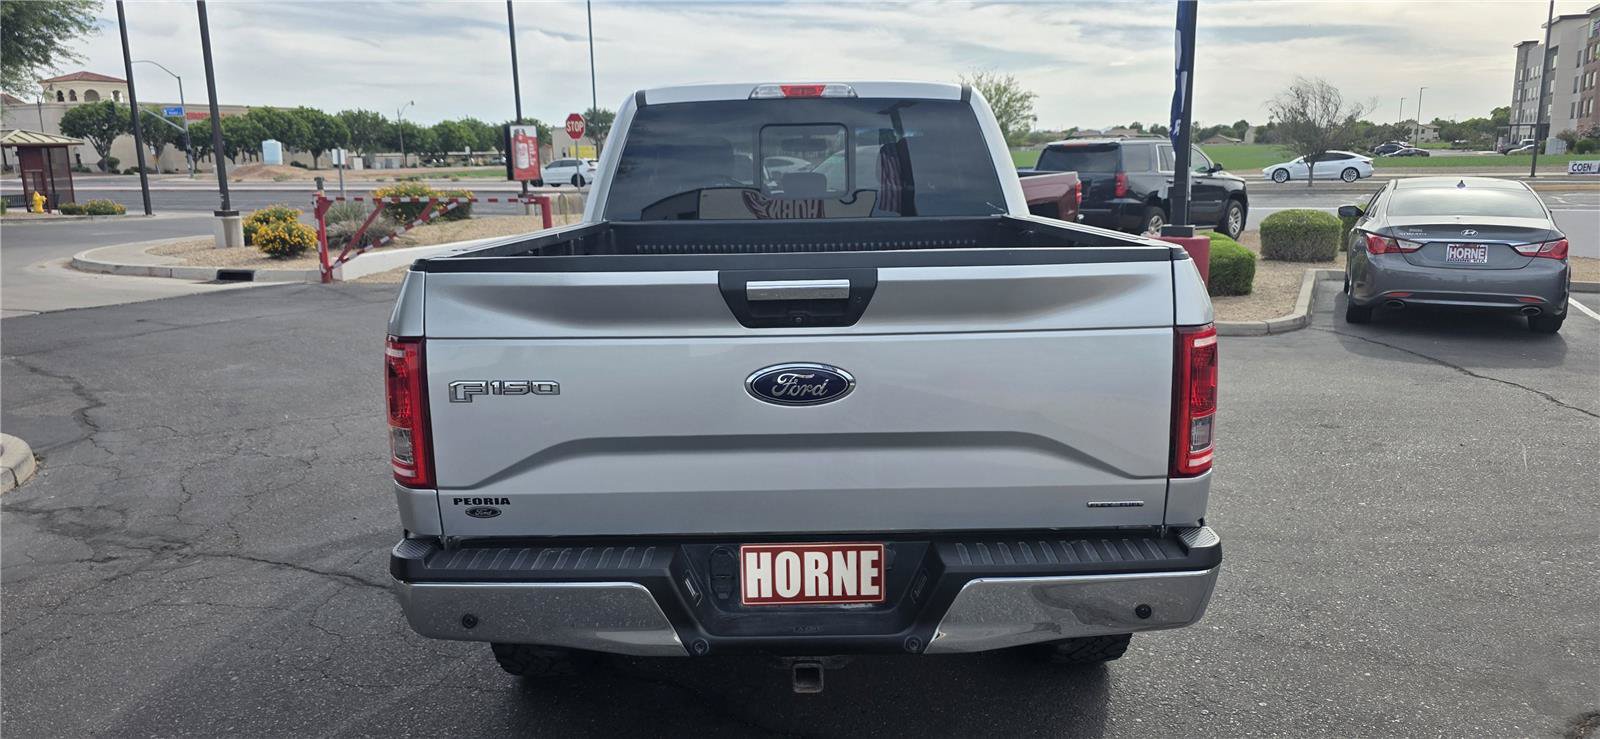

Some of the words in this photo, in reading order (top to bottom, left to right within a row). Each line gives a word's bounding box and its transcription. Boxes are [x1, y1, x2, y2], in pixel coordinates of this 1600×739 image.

[566, 121, 584, 132] STOP
[1571, 163, 1592, 172] COEN
[1448, 247, 1485, 260] HORNE
[448, 380, 560, 403] F150
[771, 373, 829, 397] Ford
[453, 497, 511, 506] PEORIA
[745, 550, 880, 598] HORNE
